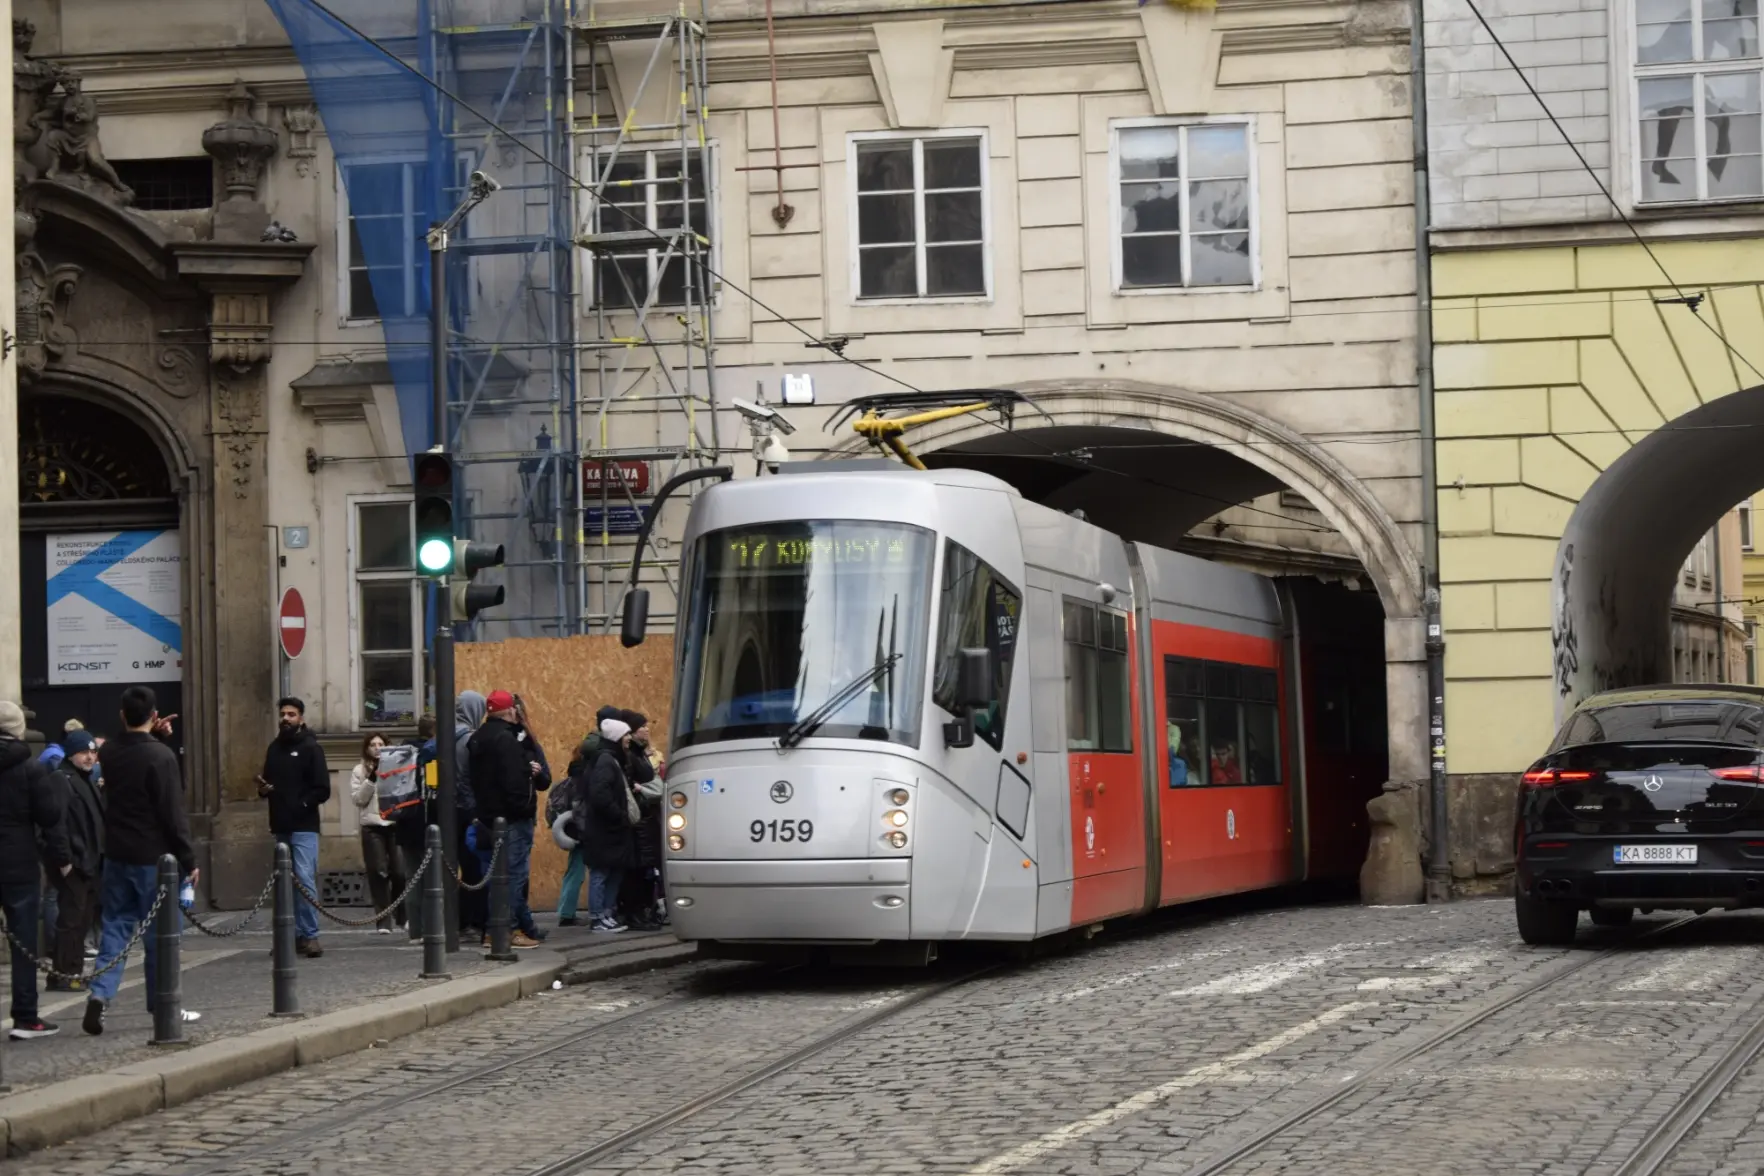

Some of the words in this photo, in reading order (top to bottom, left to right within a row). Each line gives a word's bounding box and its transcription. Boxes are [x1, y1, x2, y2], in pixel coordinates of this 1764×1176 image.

[291, 530, 300, 545] 2
[58, 661, 112, 672] KONSIT
[132, 661, 140, 669] G
[144, 660, 166, 669] HMP
[750, 819, 814, 843] 9159
[1622, 847, 1640, 860] KA
[1643, 847, 1672, 860] 8888
[1675, 847, 1695, 859] KT
